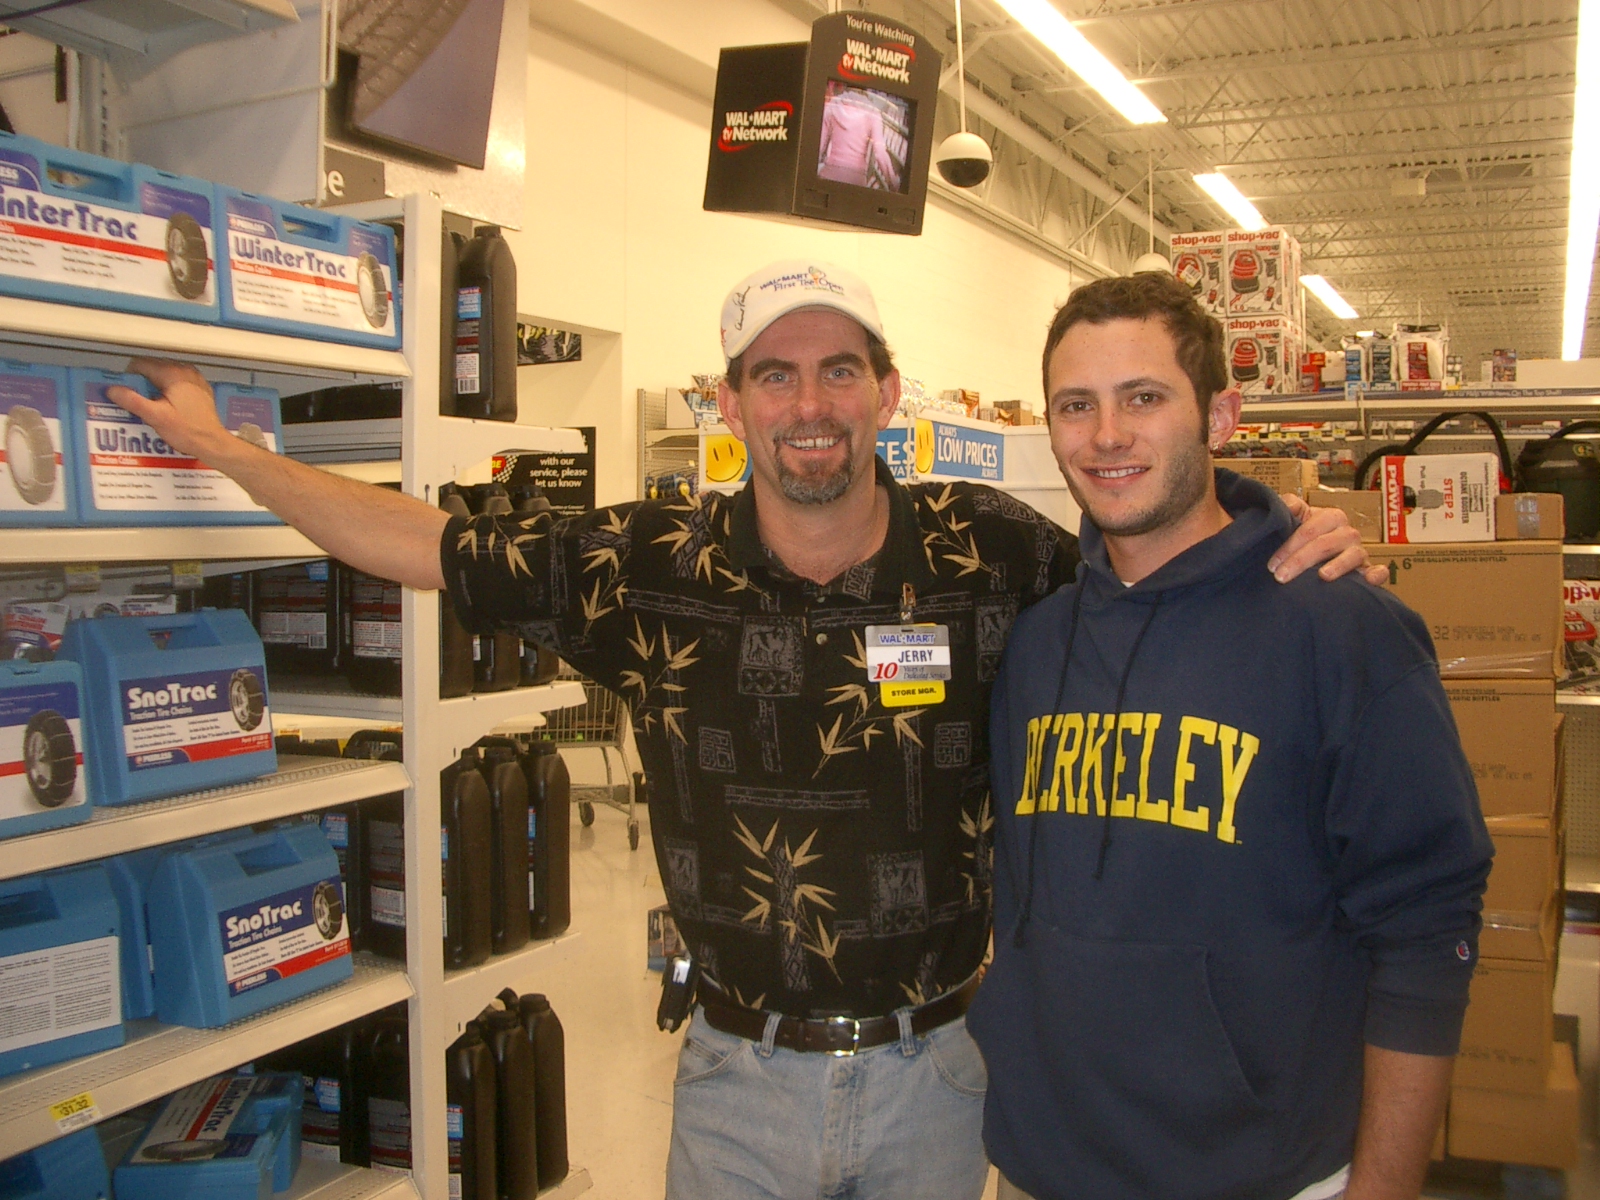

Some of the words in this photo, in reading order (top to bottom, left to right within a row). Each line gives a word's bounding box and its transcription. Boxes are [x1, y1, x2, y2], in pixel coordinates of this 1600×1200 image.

[846, 14, 874, 33] You're
[874, 22, 915, 48] Watching
[853, 57, 910, 84] Network
[732, 126, 788, 141] Network
[0, 186, 138, 240] interTrac
[1172, 234, 1222, 246] shop-vac
[1228, 231, 1280, 243] shop-vac
[234, 236, 346, 278] WinterTrac
[1229, 319, 1280, 331] shop-vac
[938, 425, 957, 437] ALWAYS
[937, 437, 964, 463] LOW
[965, 440, 998, 468] PRICES
[540, 457, 558, 466] with
[530, 468, 560, 477] service,
[561, 467, 588, 478] please
[981, 468, 998, 479] ALWAYS
[1419, 466, 1427, 480] Pull
[535, 479, 546, 488] let
[547, 480, 557, 488] us
[558, 478, 582, 488] know
[1421, 480, 1426, 489] up
[1460, 471, 1468, 494] OCTANE
[1387, 464, 1399, 537] POWER
[1443, 478, 1454, 510] STEP
[1445, 511, 1454, 519] 2
[1461, 496, 1470, 524] BOOSTER
[1402, 557, 1412, 570] 6
[1434, 626, 1450, 640] 32
[898, 649, 933, 663] JERRY
[873, 662, 899, 680] 10
[127, 682, 218, 710] SnoTrac
[891, 689, 916, 697] STORE
[130, 711, 157, 721] Traction
[156, 709, 171, 718] Tire
[170, 706, 194, 715] Chains
[1015, 712, 1260, 844] BERKELEY
[226, 900, 303, 938] SnoTrac
[228, 936, 252, 950] Traction
[251, 932, 264, 942] Tire
[263, 925, 283, 938] Chains
